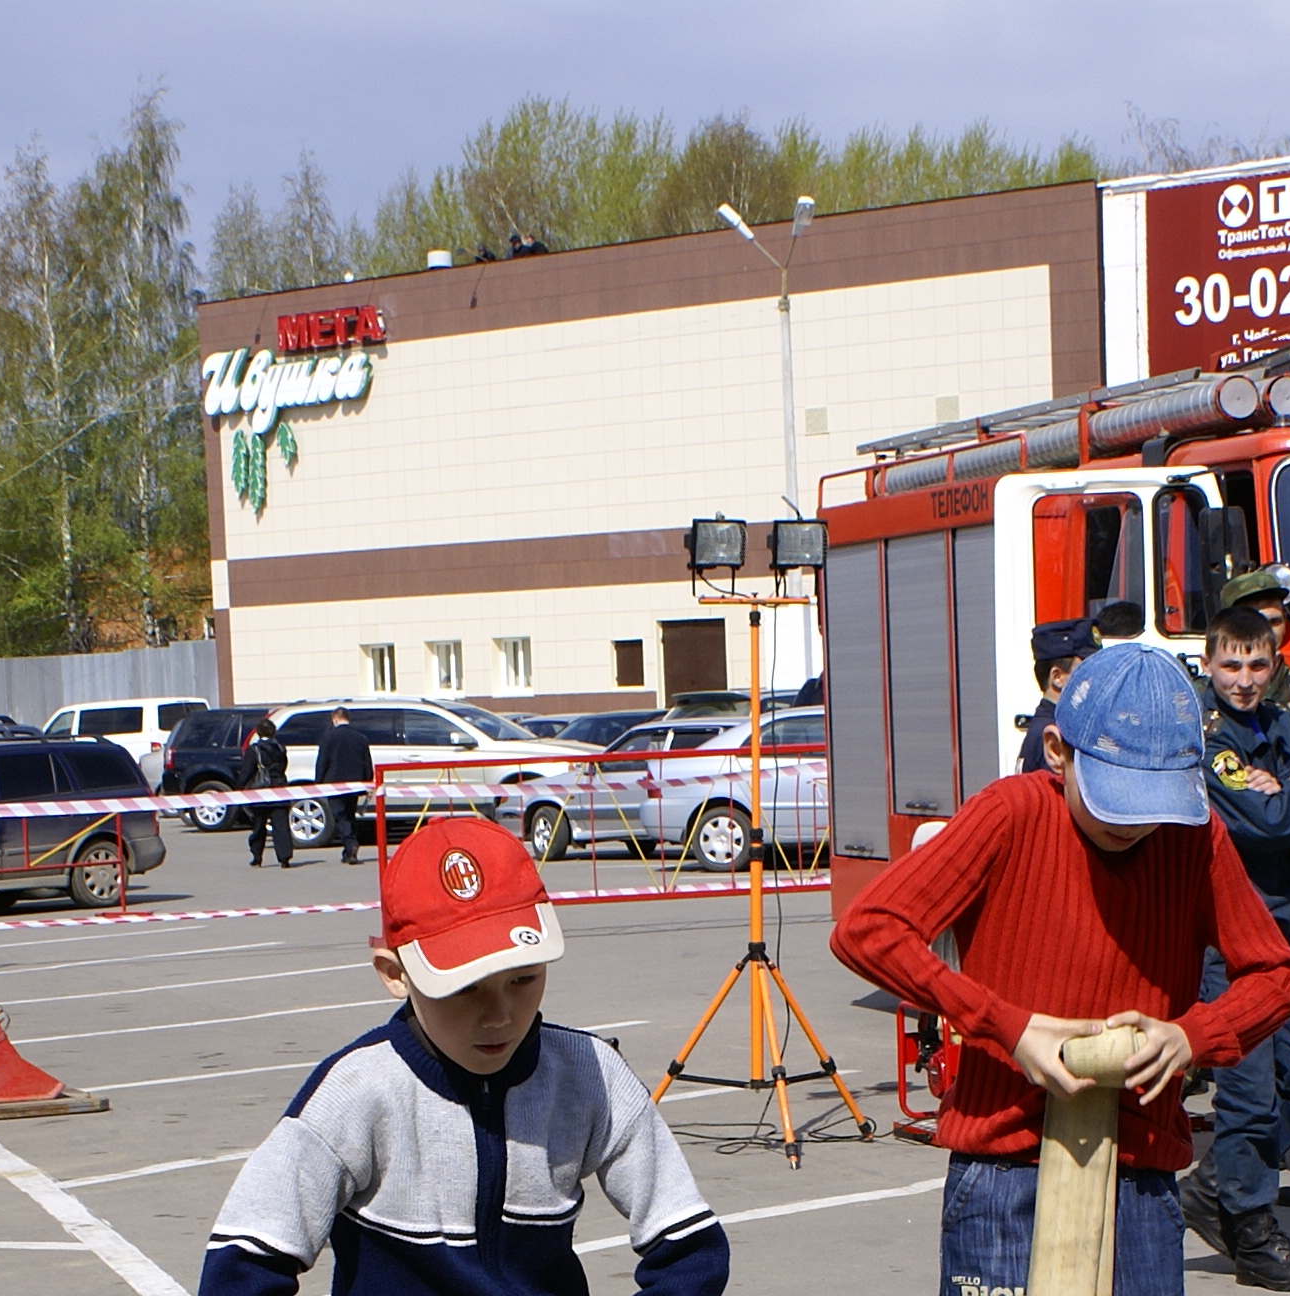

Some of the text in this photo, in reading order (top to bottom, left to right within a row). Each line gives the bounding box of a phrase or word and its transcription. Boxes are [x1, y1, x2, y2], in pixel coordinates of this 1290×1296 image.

[276, 304, 386, 351] МЕГА
[202, 347, 373, 435] Ивушка
[930, 482, 989, 520] ТЕЛЕФОН
